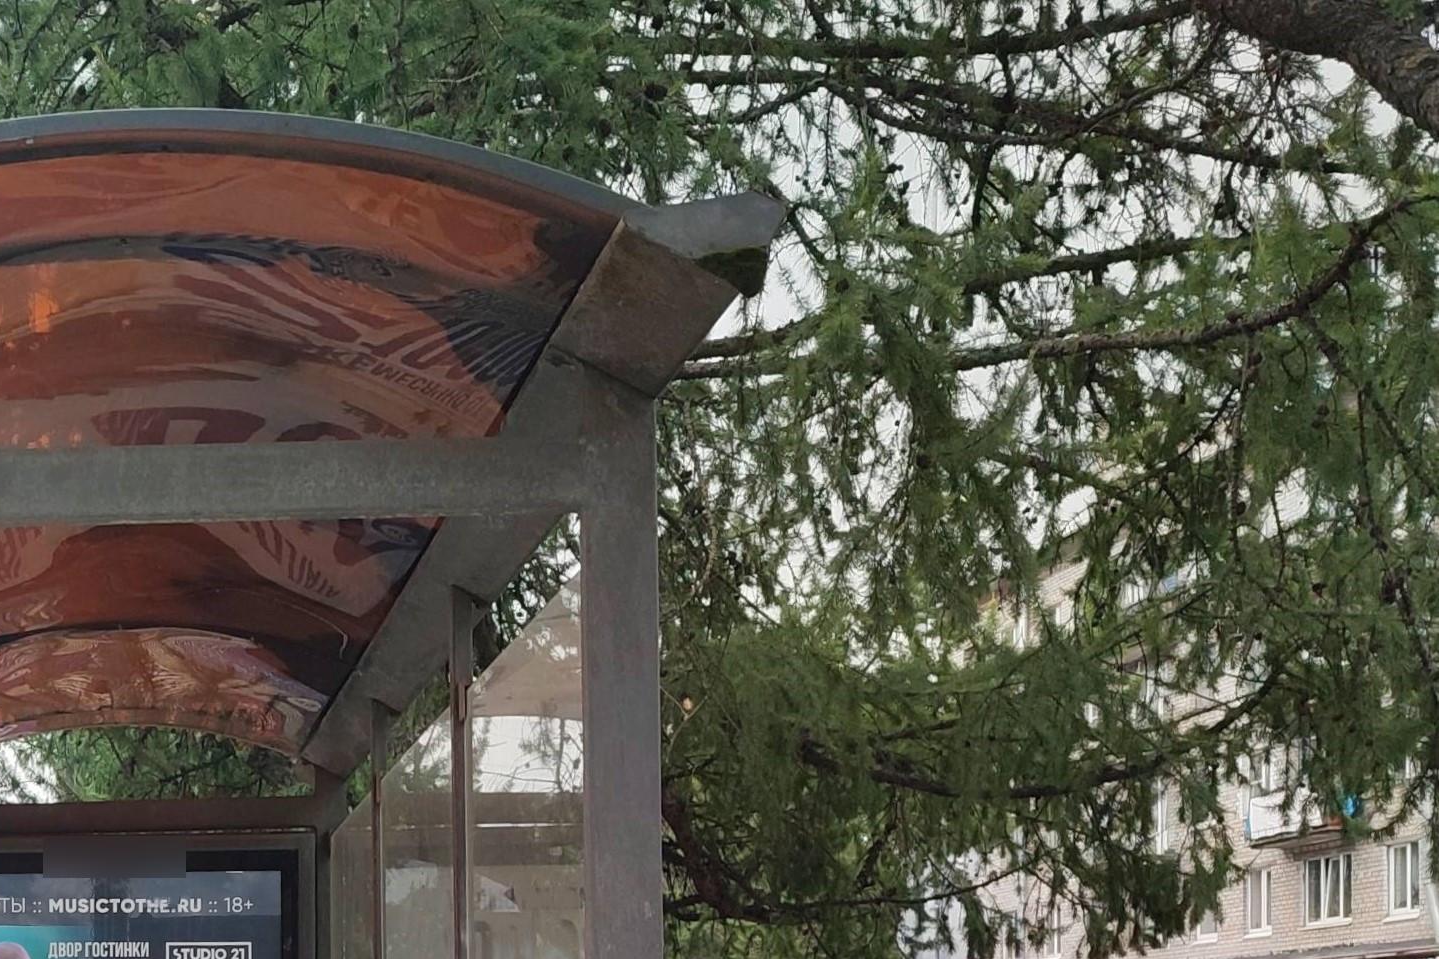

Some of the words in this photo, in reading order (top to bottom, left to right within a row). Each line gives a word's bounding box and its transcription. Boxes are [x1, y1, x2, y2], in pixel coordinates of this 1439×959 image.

[48, 898, 203, 914] MUSICTOTHE.RU
[224, 897, 254, 913] 18+
[48, 942, 82, 959] ДВОР
[84, 941, 150, 959] ГОСТИНКИ
